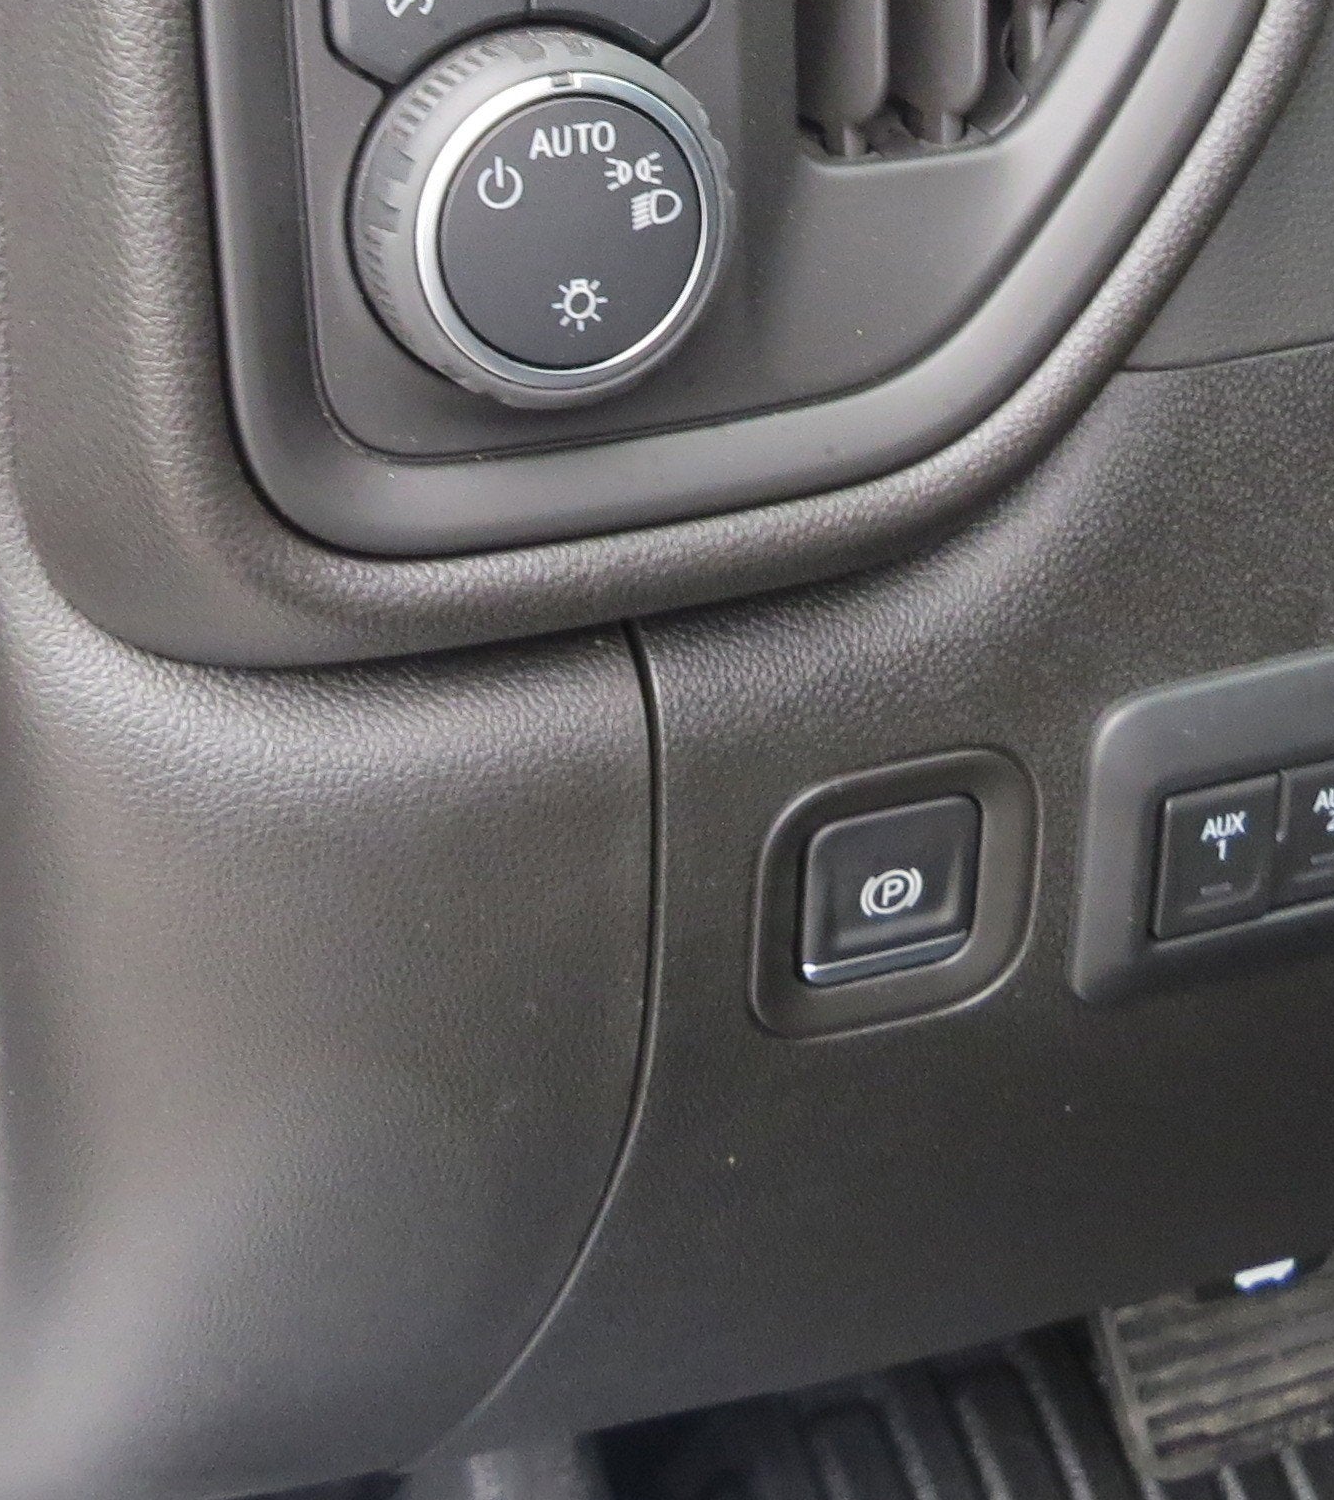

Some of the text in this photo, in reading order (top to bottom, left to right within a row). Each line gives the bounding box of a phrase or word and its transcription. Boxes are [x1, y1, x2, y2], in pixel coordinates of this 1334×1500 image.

[529, 120, 617, 161] AUTO
[1200, 810, 1247, 842] AUX
[1217, 838, 1228, 861] 1
